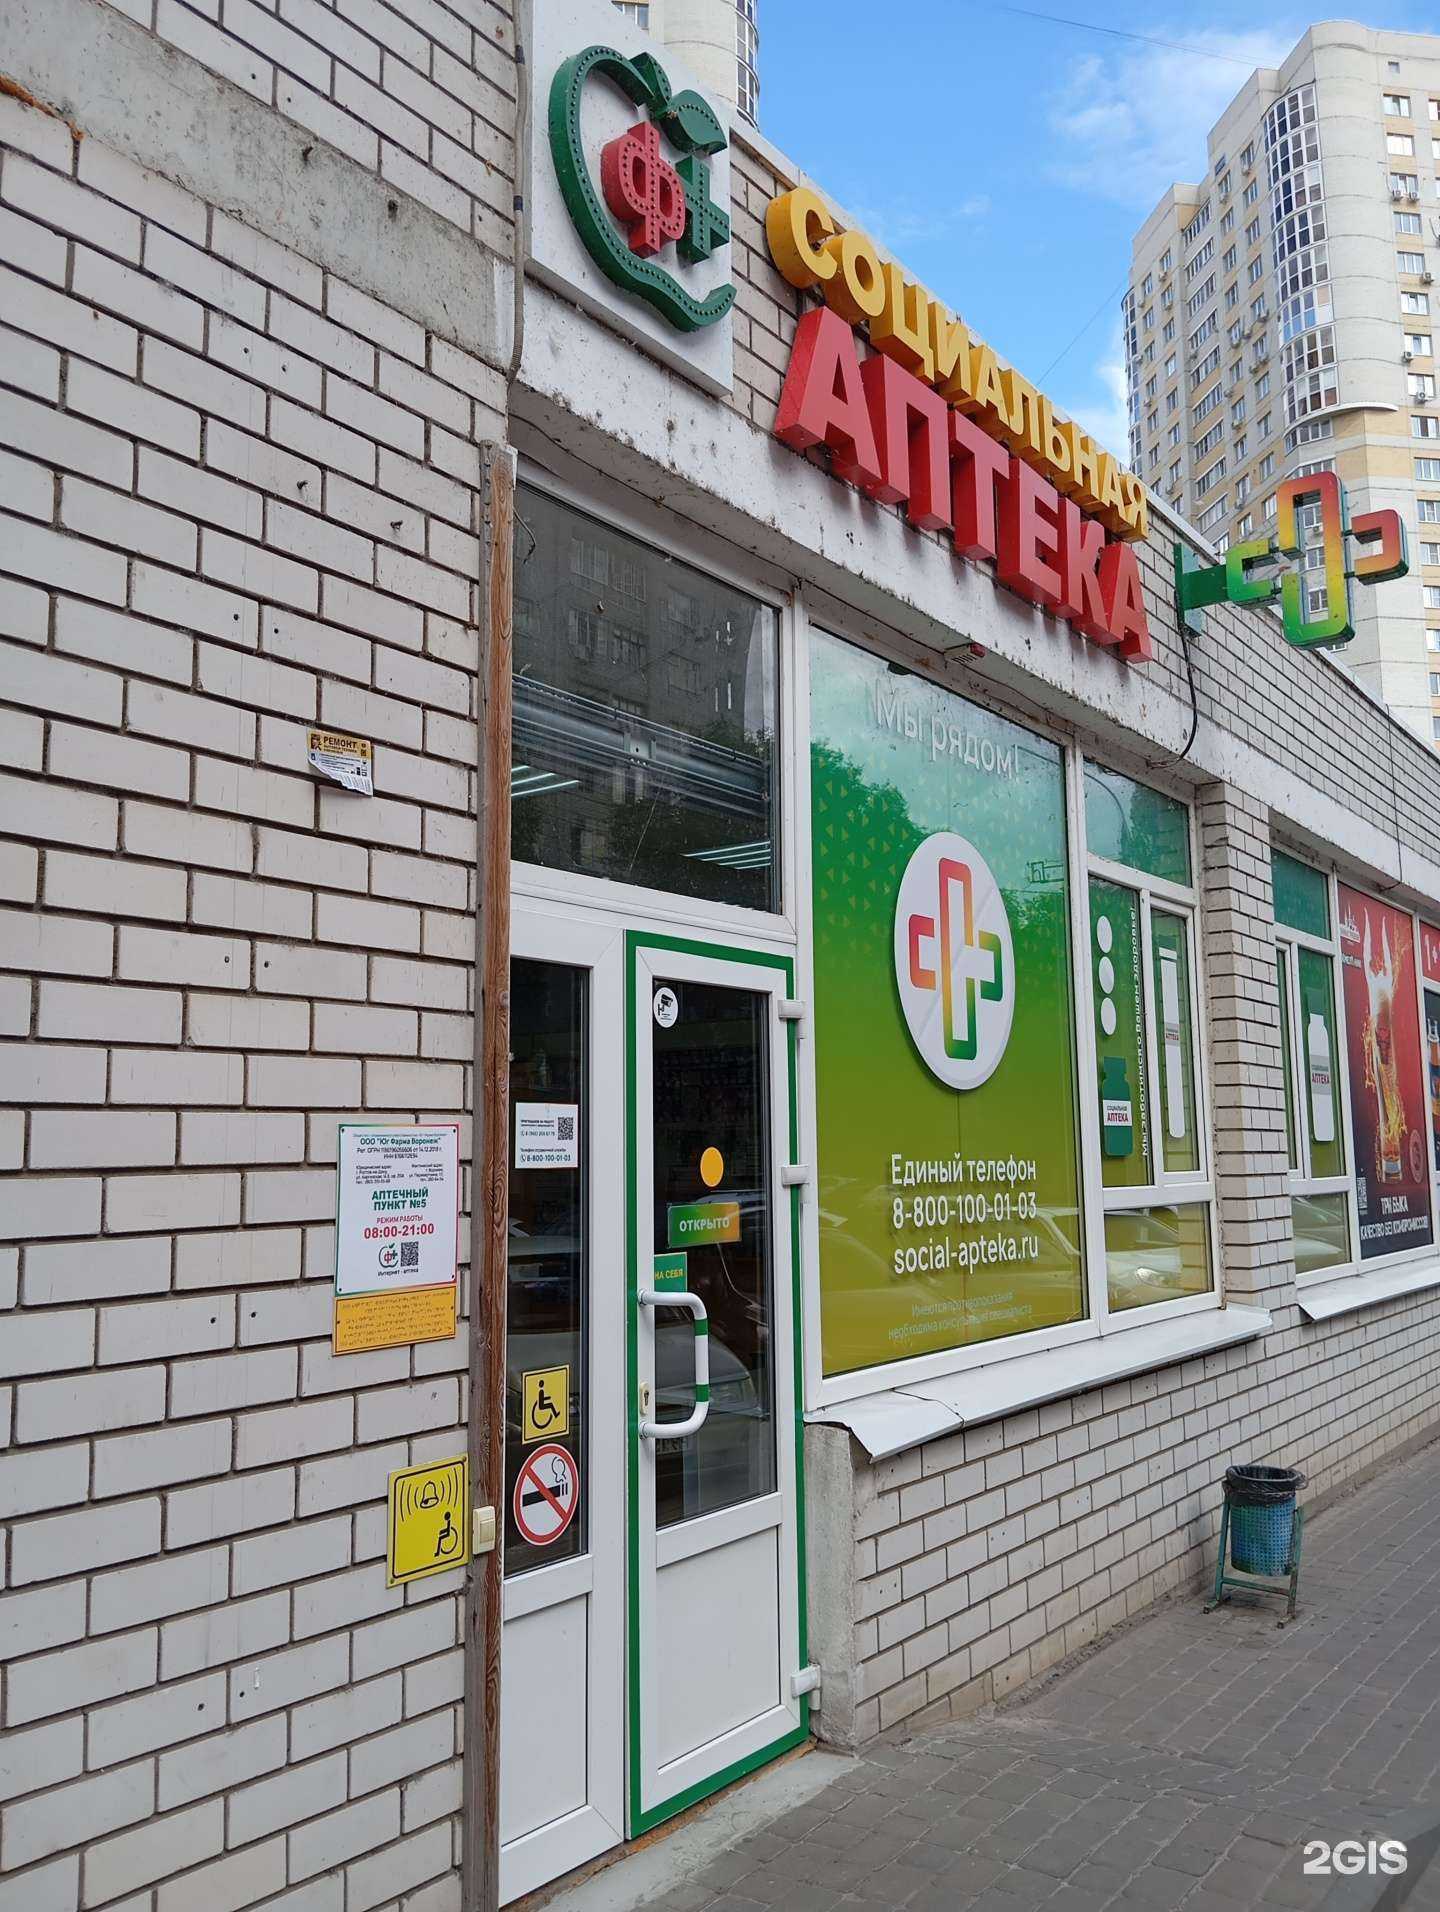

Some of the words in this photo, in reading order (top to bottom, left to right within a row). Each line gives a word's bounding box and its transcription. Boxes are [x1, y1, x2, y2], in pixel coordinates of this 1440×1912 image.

[765, 187, 1148, 541] СОЦИАЛЬНАЯ
[773, 306, 1152, 663] АПТЕКА
[874, 678, 923, 741] Мы
[930, 714, 1020, 782] рядом!
[323, 736, 357, 749] РЕМОНТ
[1312, 1072, 1330, 1084] АПТЕКА
[1138, 1048, 1148, 1129] заботимся
[1107, 1112, 1129, 1122] АПТЕКА
[391, 1138, 410, 1146] Фарма
[1142, 1132, 1148, 1156] Мы
[891, 1152, 963, 1186] Единый
[966, 1154, 1036, 1188] телефон
[372, 1186, 428, 1200] АПТЕЧНЫЙ
[374, 1200, 407, 1211] ПУНКТ
[410, 1199, 426, 1208] №5
[892, 1192, 1037, 1230] 8-800-100-01-03
[376, 1216, 399, 1224] РЕЖИМ
[400, 1214, 423, 1222] РАБОТЫ
[680, 1217, 730, 1232] ОТКРЫТО
[364, 1223, 434, 1239] 08:00-21:00
[894, 1232, 1038, 1274] social-apteka.ru
[654, 1271, 664, 1280] НА
[665, 1268, 684, 1279] СЕБЯ
